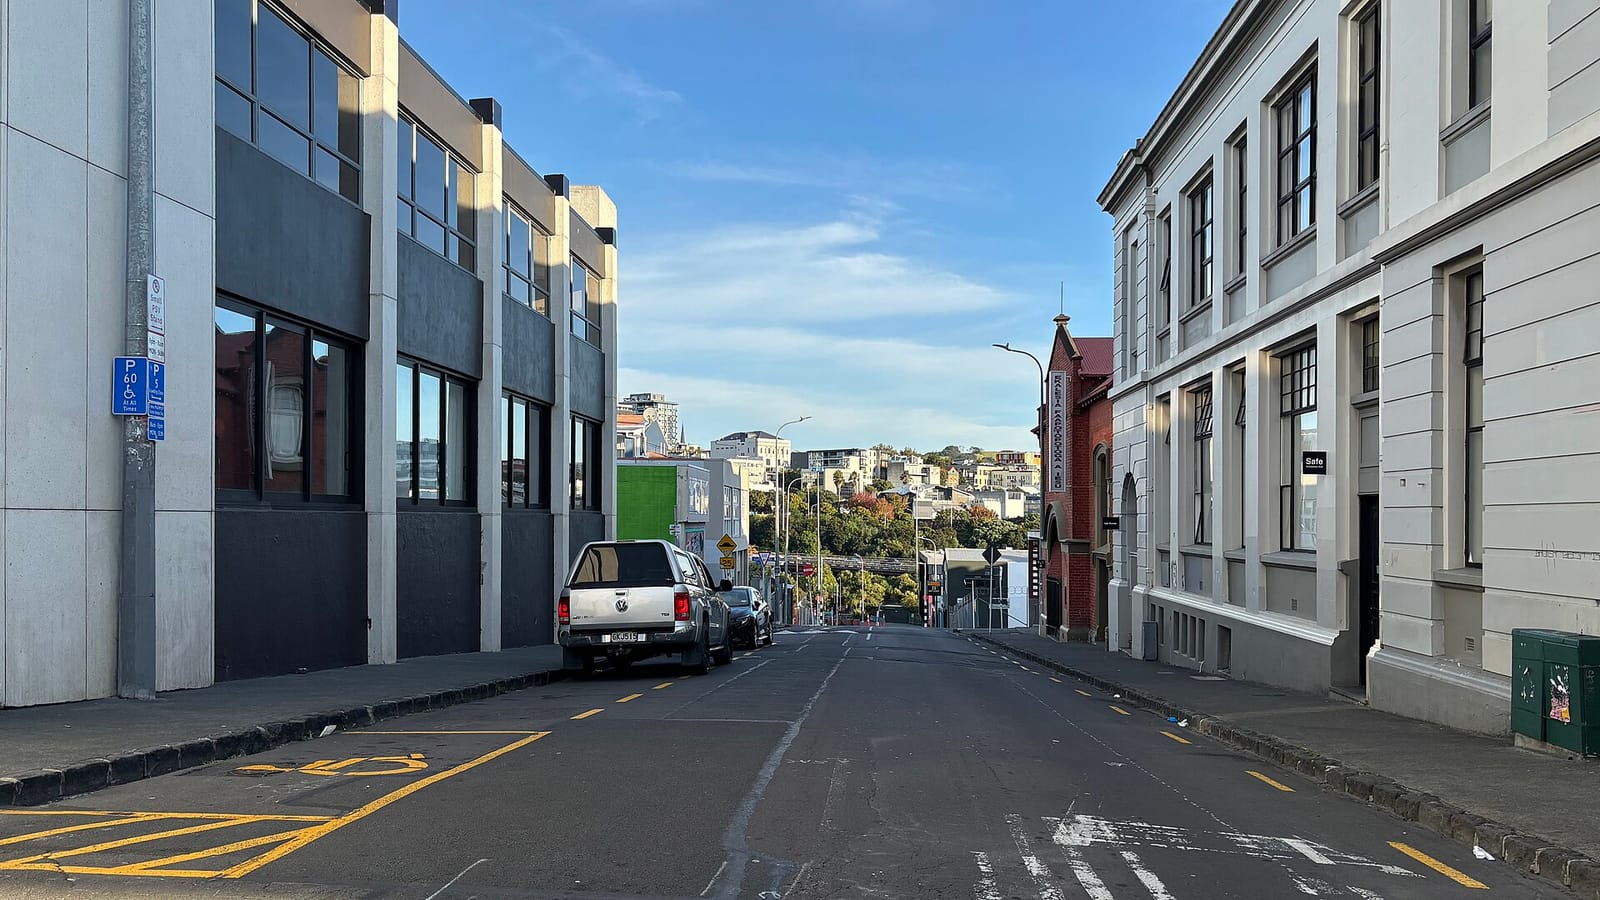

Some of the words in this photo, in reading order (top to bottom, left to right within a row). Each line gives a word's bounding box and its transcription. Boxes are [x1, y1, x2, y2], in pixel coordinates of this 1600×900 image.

[125, 359, 136, 372] P
[153, 364, 160, 377] P
[123, 373, 137, 384] 60
[154, 379, 159, 389] 5
[1305, 457, 1324, 465] Safe
[721, 559, 732, 567] 25
